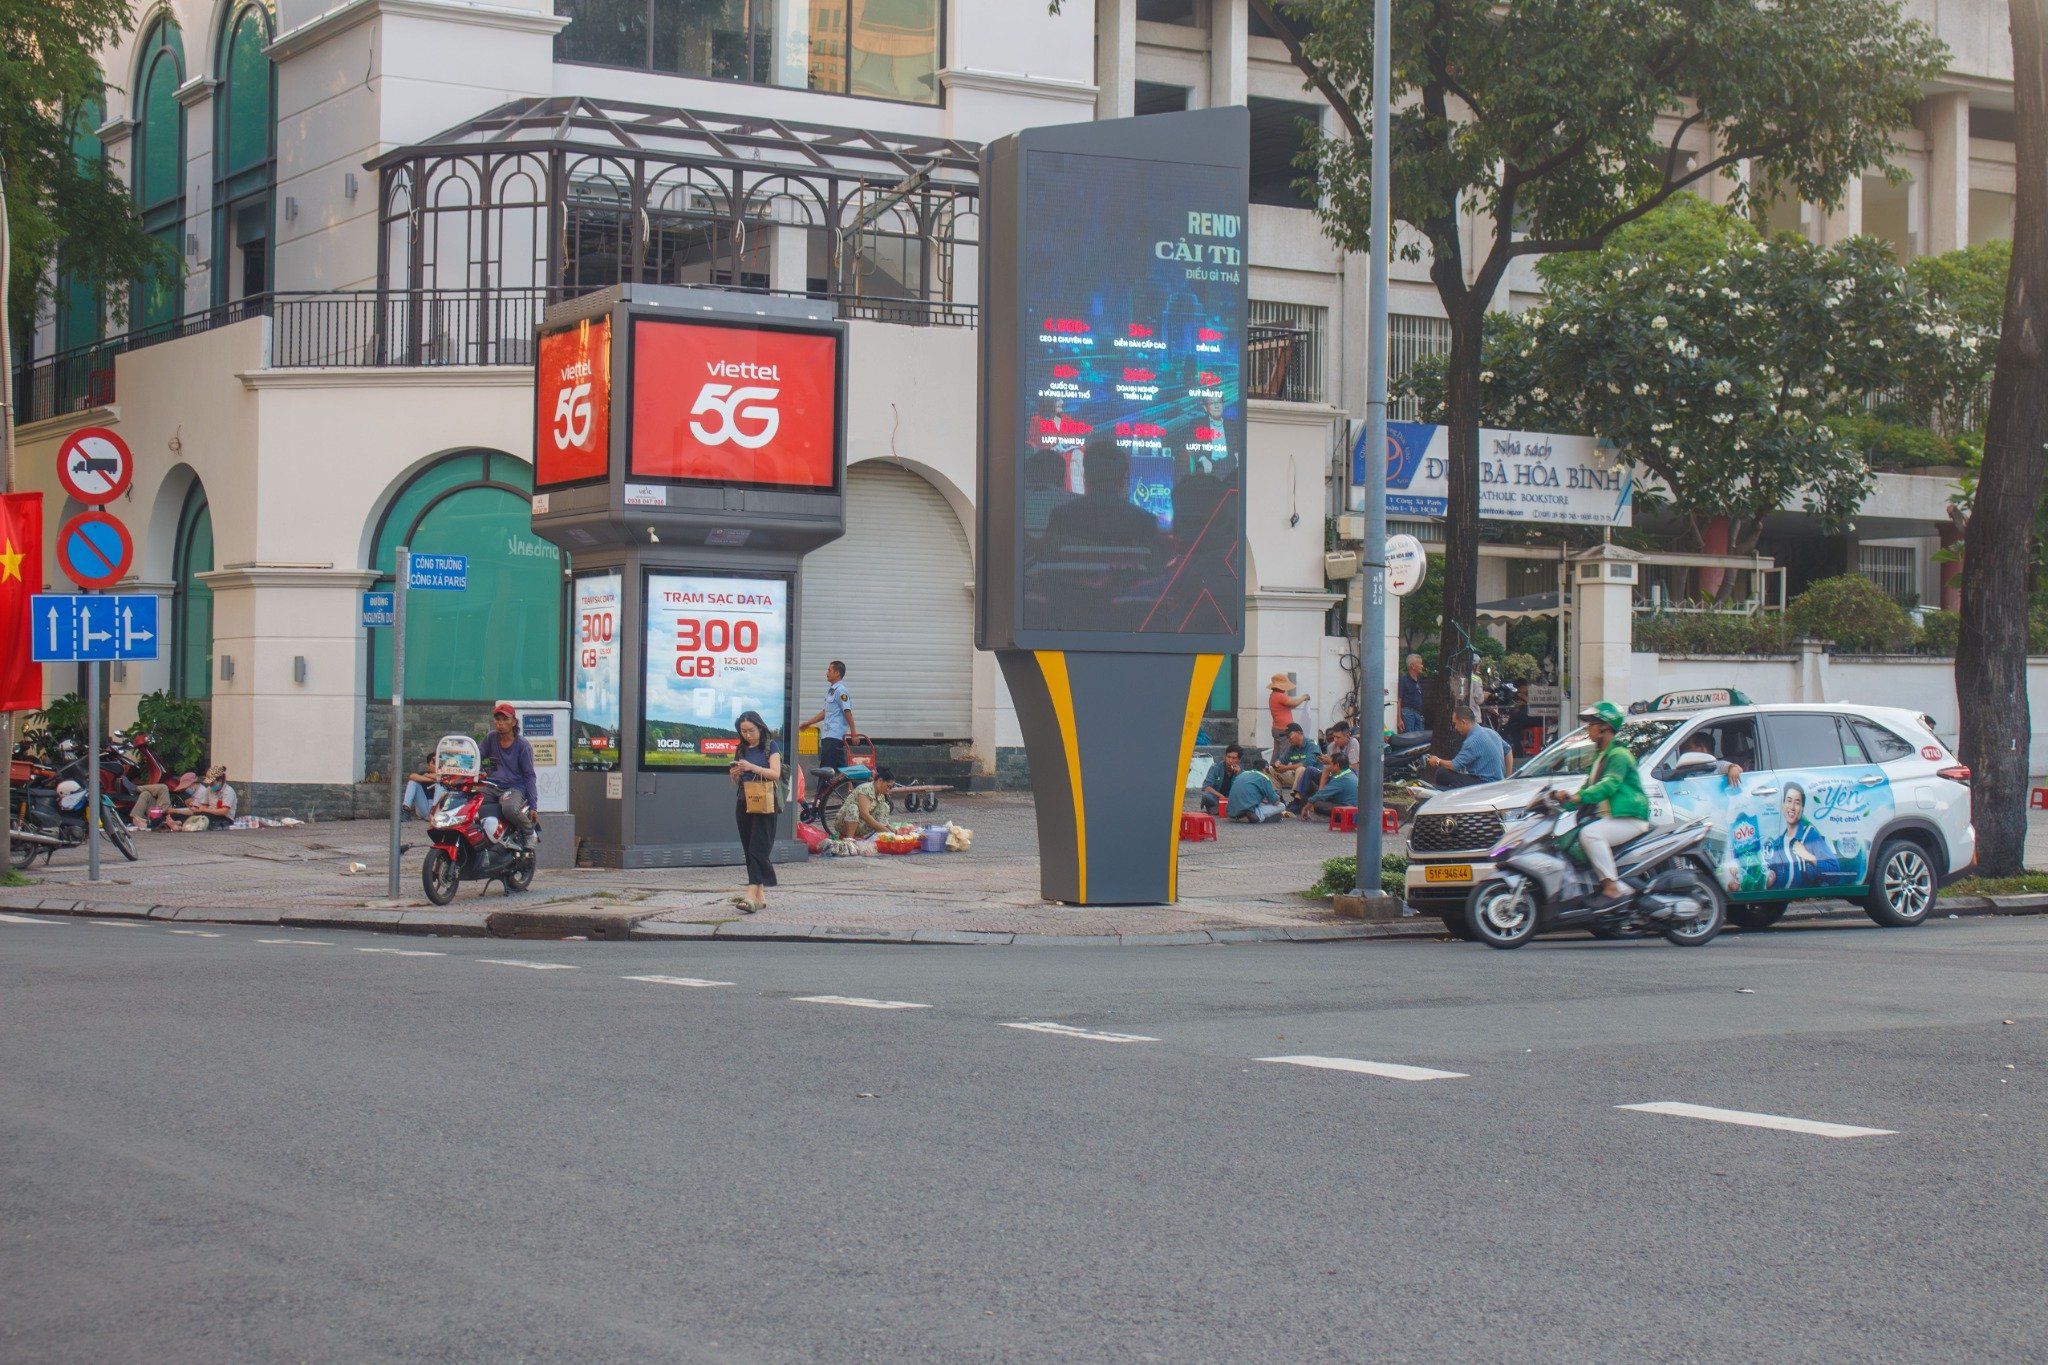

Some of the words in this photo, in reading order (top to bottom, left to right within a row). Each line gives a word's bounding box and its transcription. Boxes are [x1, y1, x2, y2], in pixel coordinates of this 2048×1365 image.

[1155, 237, 1203, 262] CẢI
[561, 359, 592, 381] viettel
[706, 360, 781, 381] viettel
[554, 382, 592, 450] 5G
[690, 383, 780, 449] 5G
[1524, 436, 1552, 460] sách
[1481, 459, 1508, 484] BÀ
[1566, 464, 1622, 492] BÌNH
[1480, 490, 1516, 501] ATHOLIC
[1521, 493, 1569, 505] BOOKSTORE
[410, 572, 432, 586] CÔNG
[444, 576, 467, 587] PARIS
[663, 592, 704, 604] TRẠM
[707, 593, 733, 606] SẠC
[737, 595, 772, 606] DATA
[582, 612, 613, 643] 300
[676, 618, 759, 653] 300
[582, 648, 597, 668] GB
[676, 655, 715, 678] GB
[724, 657, 758, 665] 125.000
[1677, 694, 1712, 704] VINASUN
[1712, 692, 1727, 702] TAXI
[657, 739, 680, 748] 10GB
[1654, 809, 1662, 817] 27
